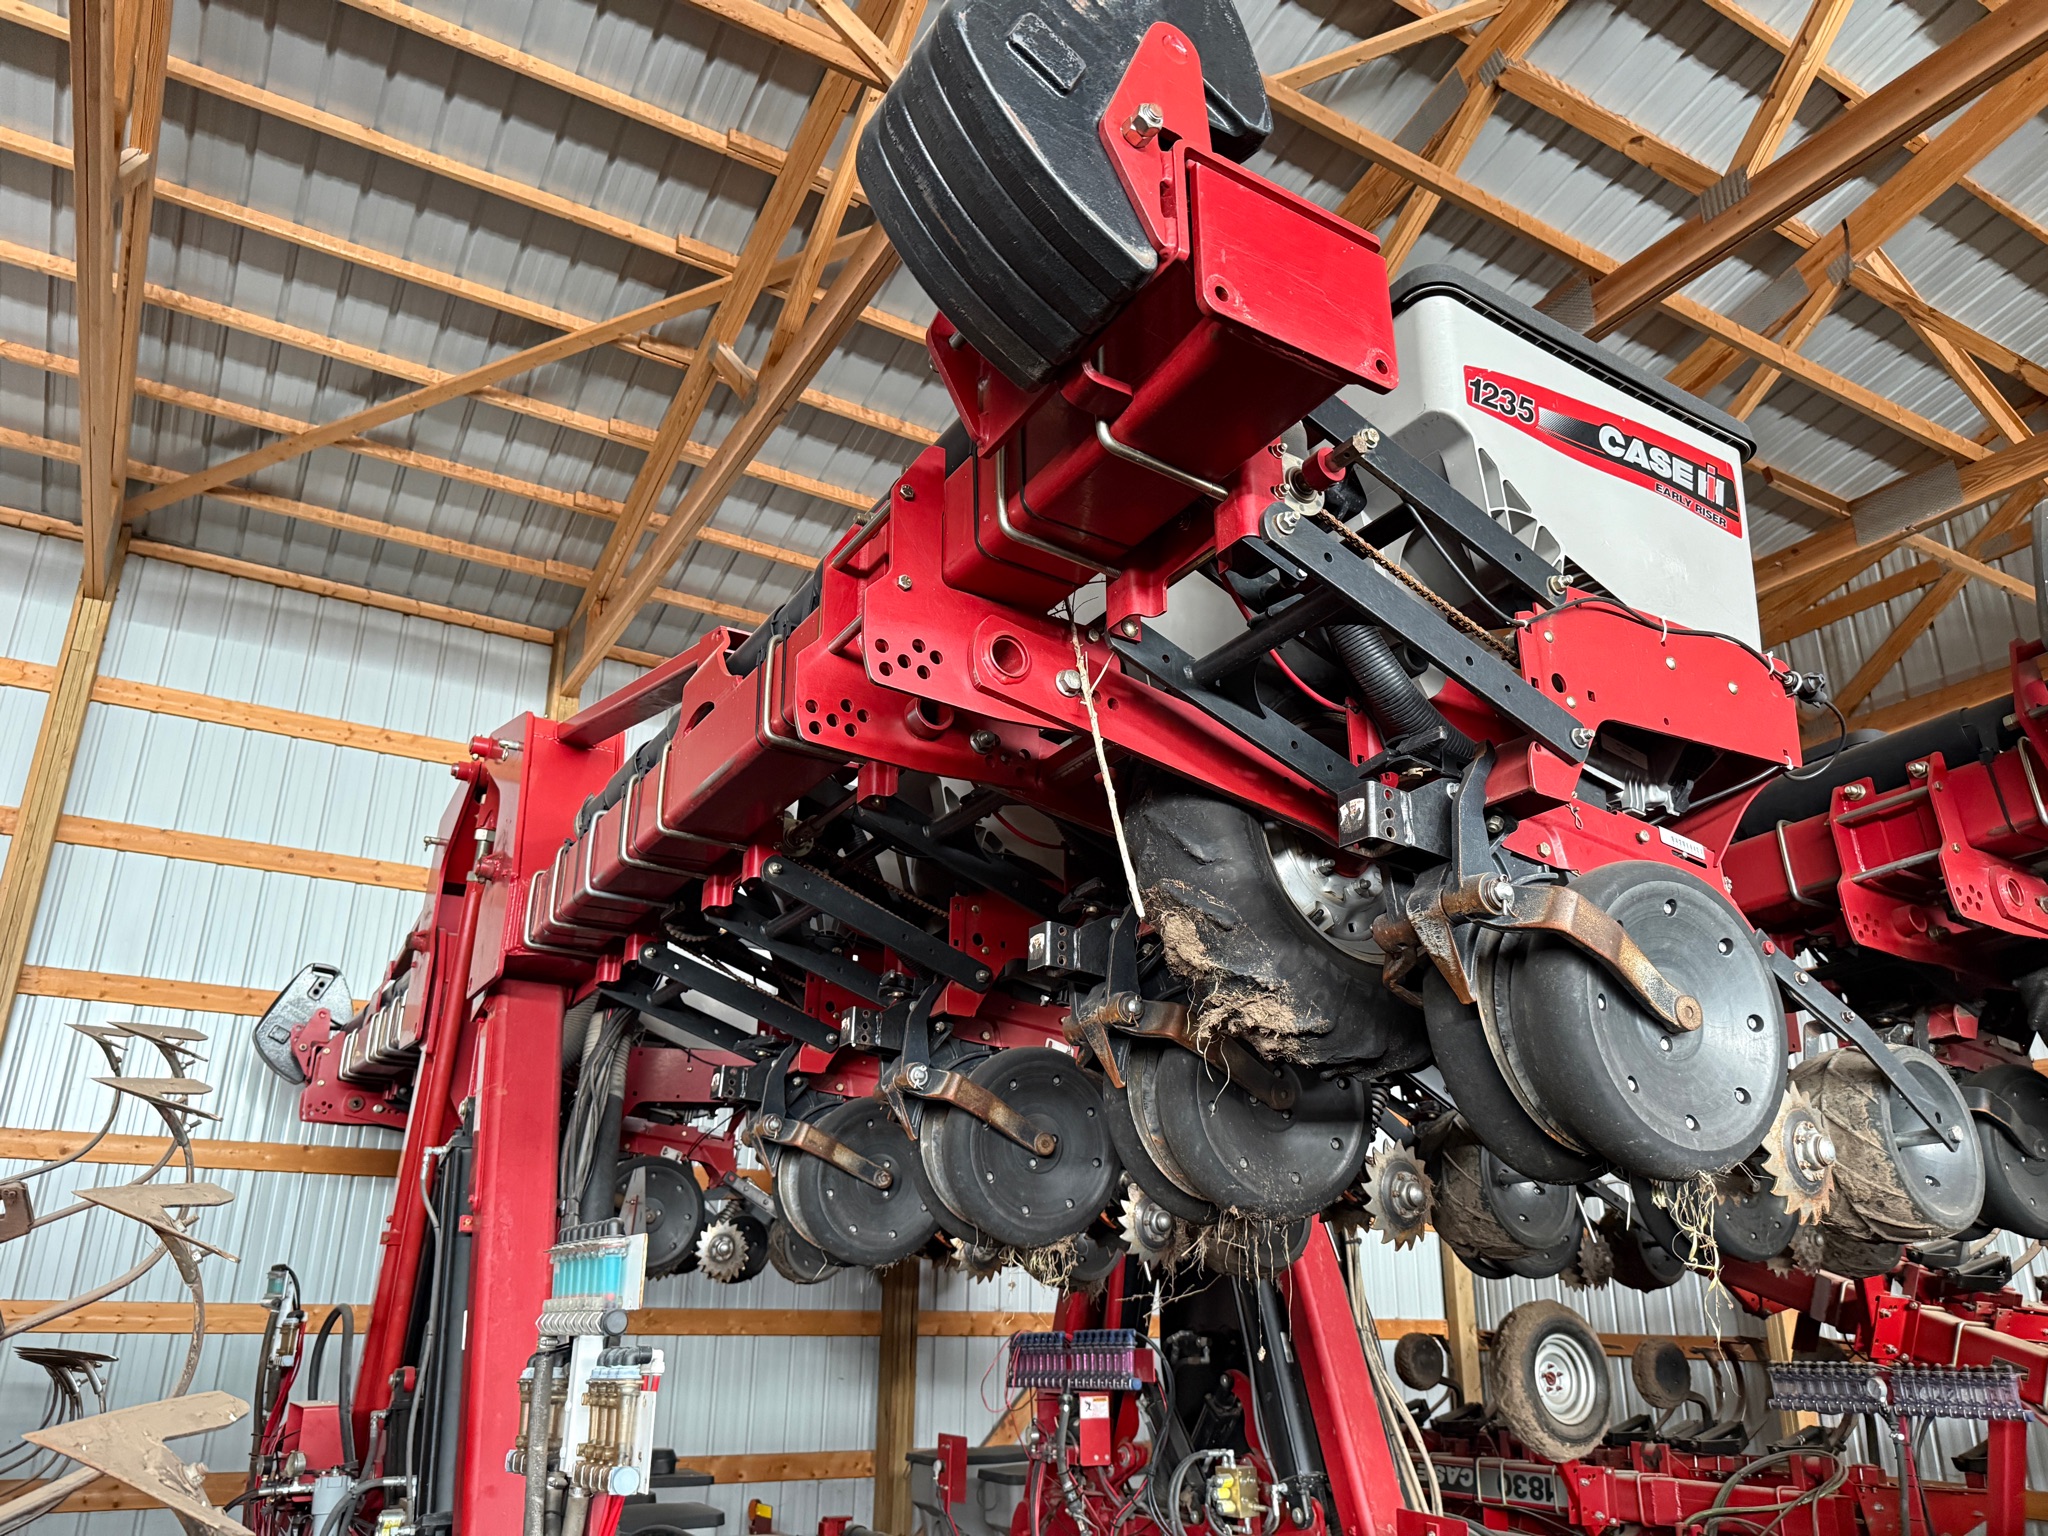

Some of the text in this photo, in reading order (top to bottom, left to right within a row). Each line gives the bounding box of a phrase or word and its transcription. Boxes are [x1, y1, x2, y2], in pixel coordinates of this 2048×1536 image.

[1469, 376, 1535, 424] 1235
[1598, 425, 1694, 490] CASE
[1654, 483, 1727, 528] EARLY RISER
[1497, 1472, 1555, 1502] 1830
